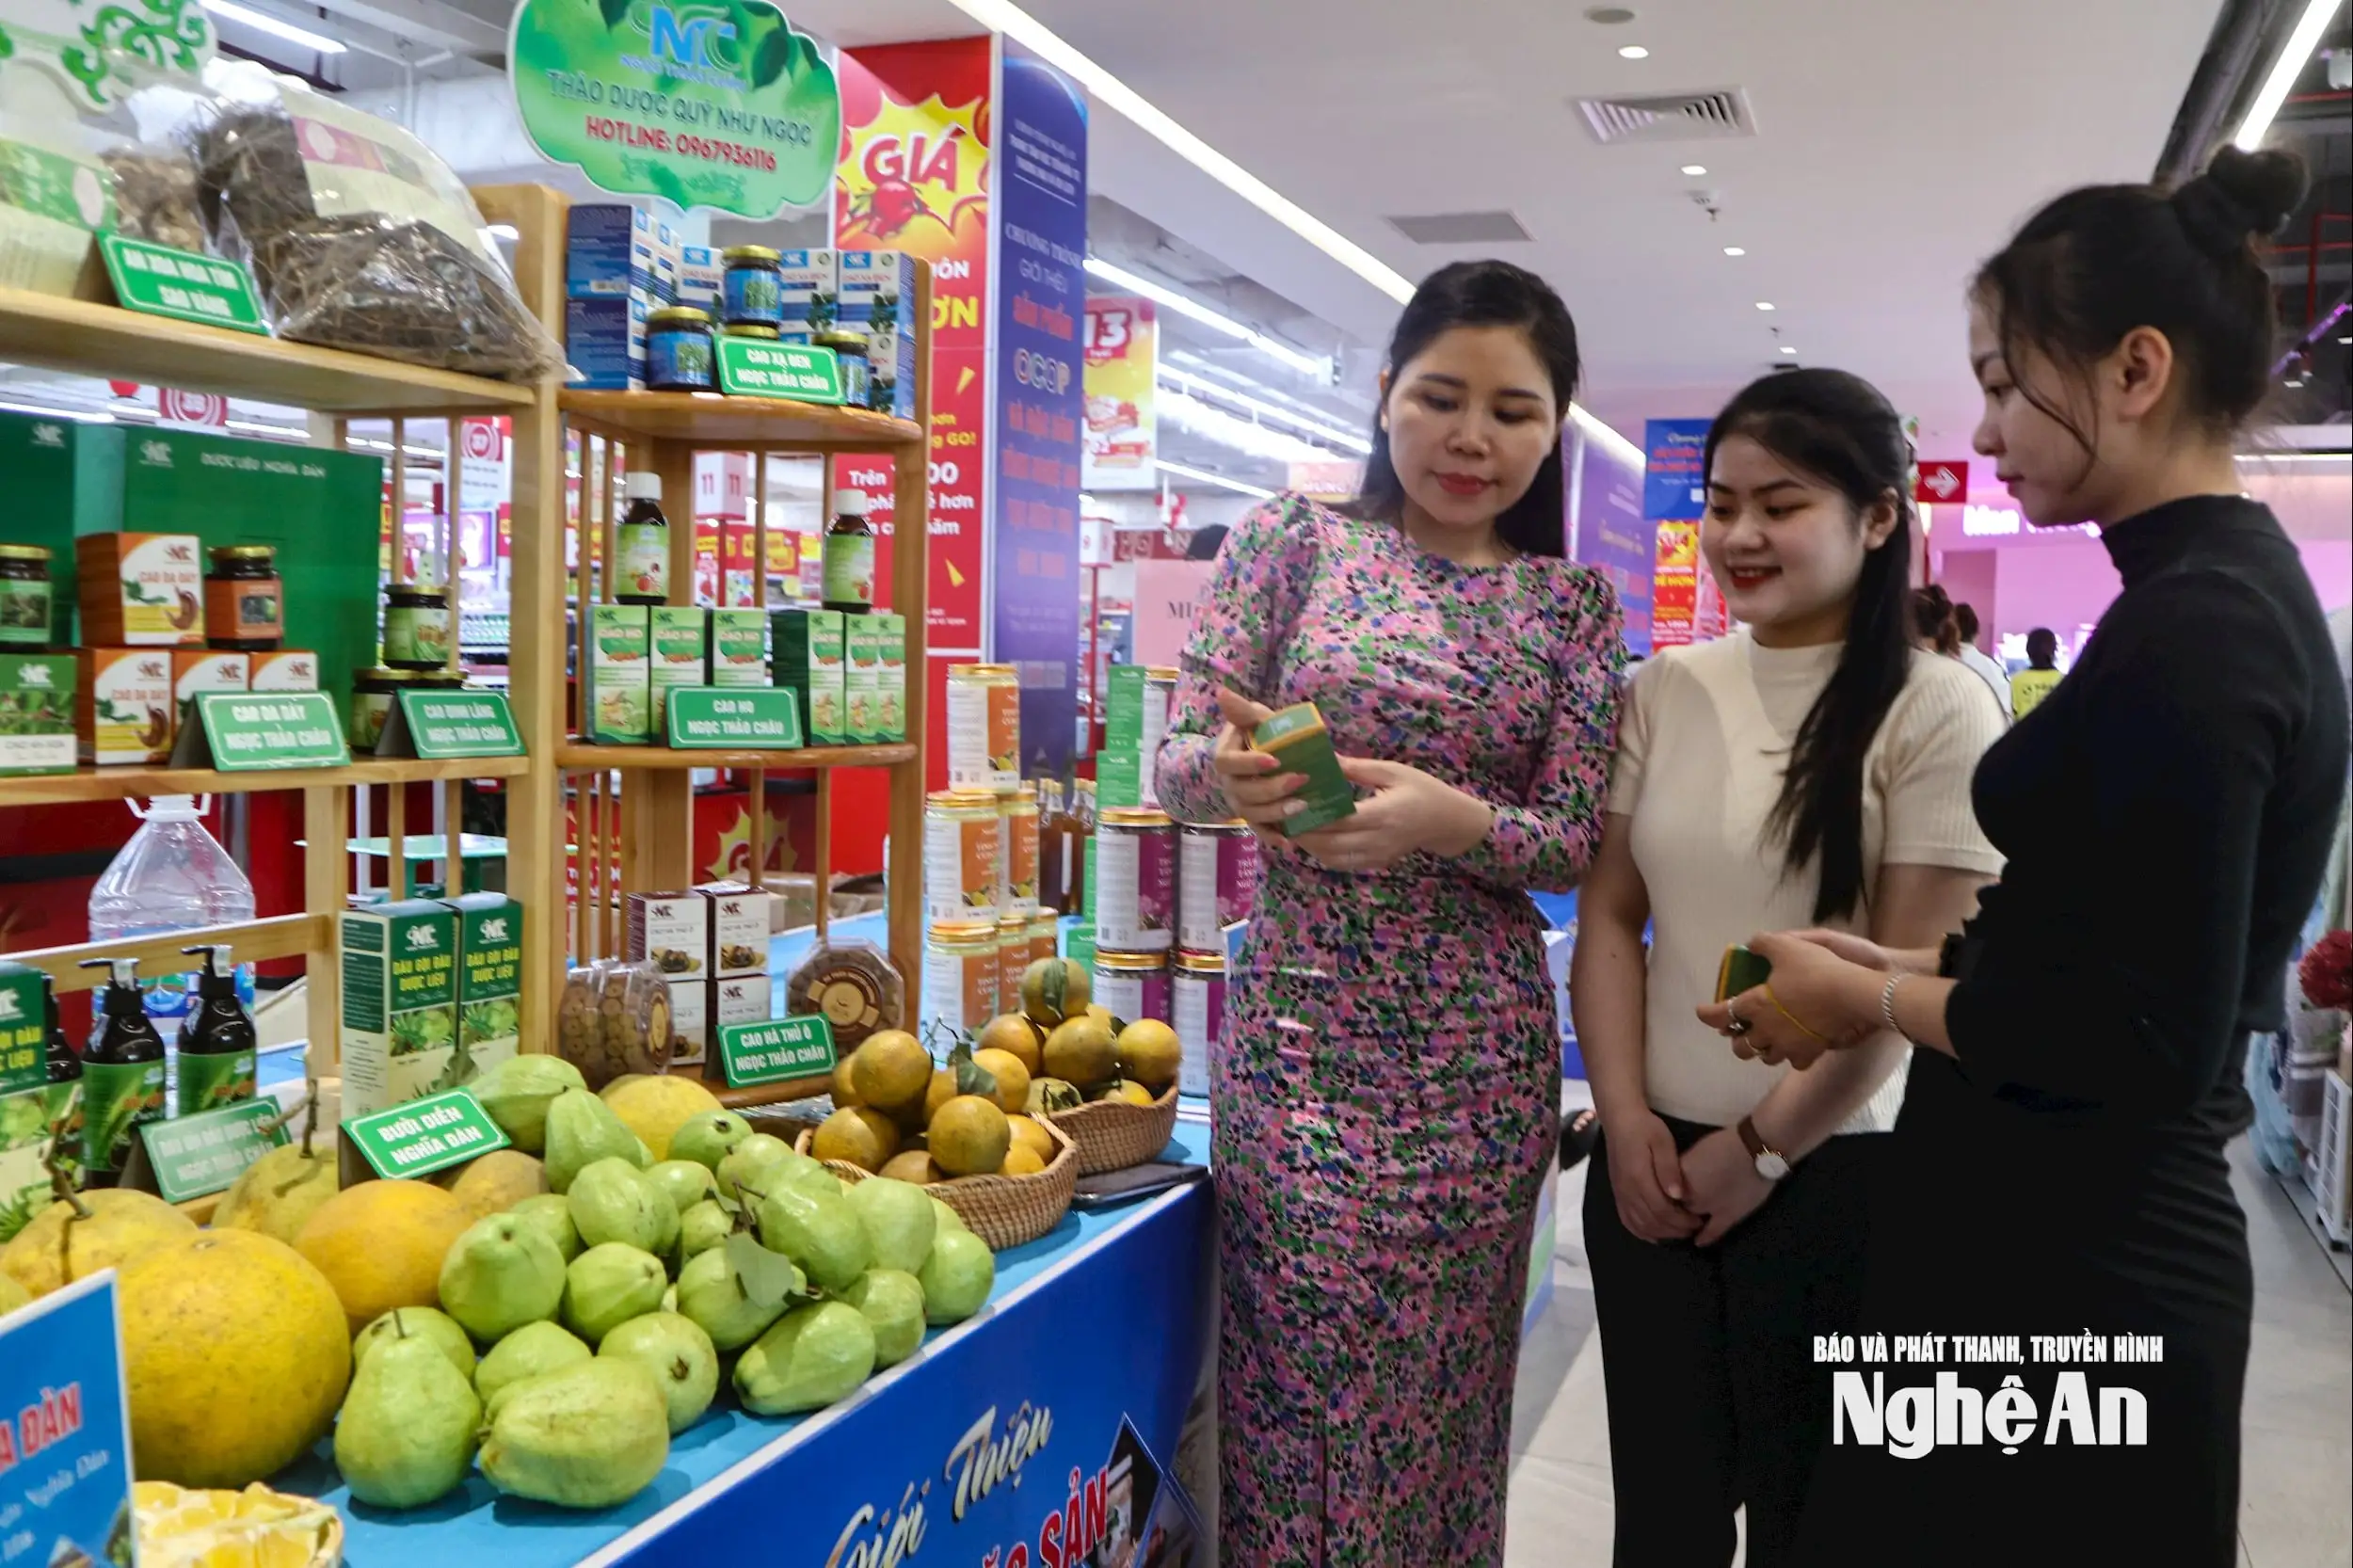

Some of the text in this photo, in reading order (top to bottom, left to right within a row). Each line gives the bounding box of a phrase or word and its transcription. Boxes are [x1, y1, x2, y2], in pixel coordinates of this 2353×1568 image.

[545, 67, 602, 104] THẢO
[609, 85, 667, 120] DƯỢC
[717, 108, 756, 135] NHƯ
[760, 117, 812, 149] NGỌC
[584, 115, 777, 173] HOTLINE: 0967936116
[863, 125, 966, 192] GIÁ
[1013, 347, 1072, 395] OCOP
[849, 470, 887, 487] Trên
[940, 492, 975, 510] hơn
[712, 699, 755, 713] CAO HO
[687, 716, 785, 737] NGỌC THẢO CHÂU
[740, 1023, 812, 1048] CAO HÀ THỦ Ô
[735, 1045, 825, 1072] NGỌC THẢO CHÂU
[389, 1126, 484, 1165] NGHĨA ĐÀN
[19, 1382, 82, 1458] ĐÀN
[1039, 1465, 1109, 1568] SẢN
